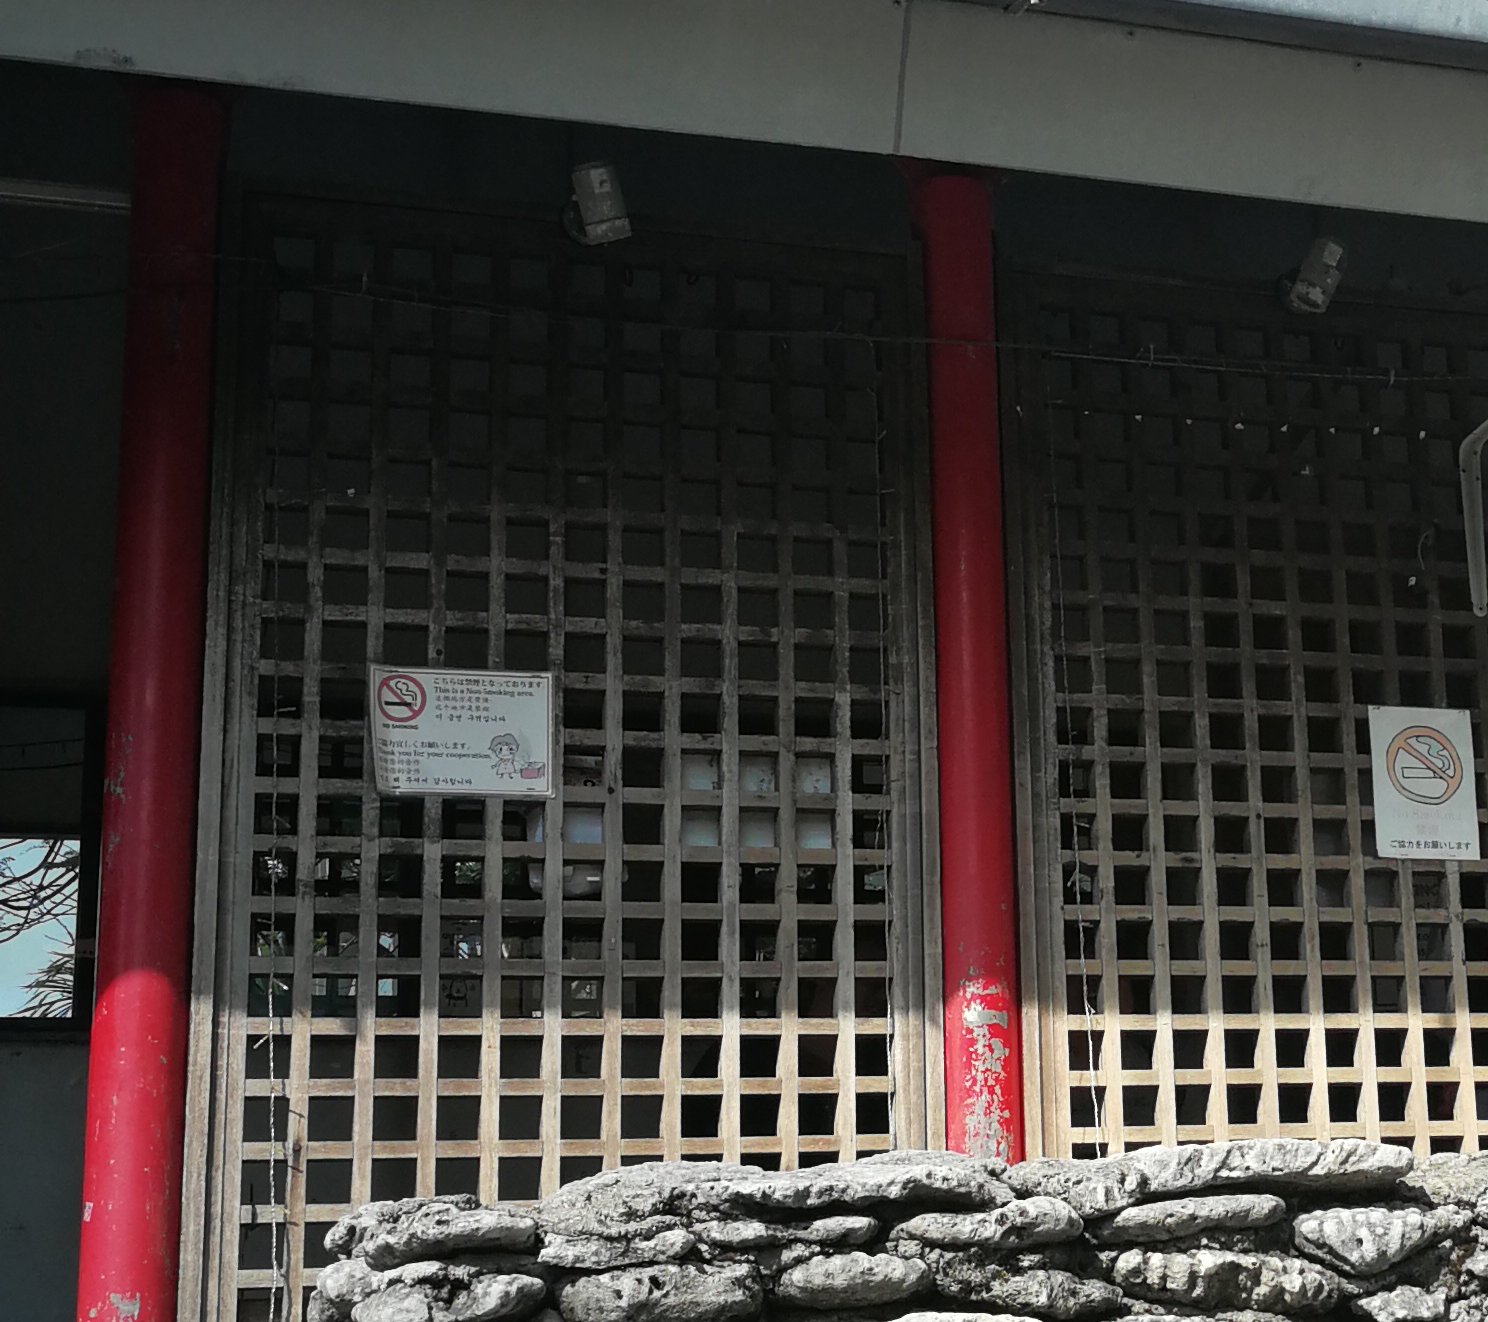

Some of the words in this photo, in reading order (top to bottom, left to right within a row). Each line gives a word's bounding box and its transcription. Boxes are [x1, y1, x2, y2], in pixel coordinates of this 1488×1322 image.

[1390, 839, 1472, 852] ご協力をお願いします
